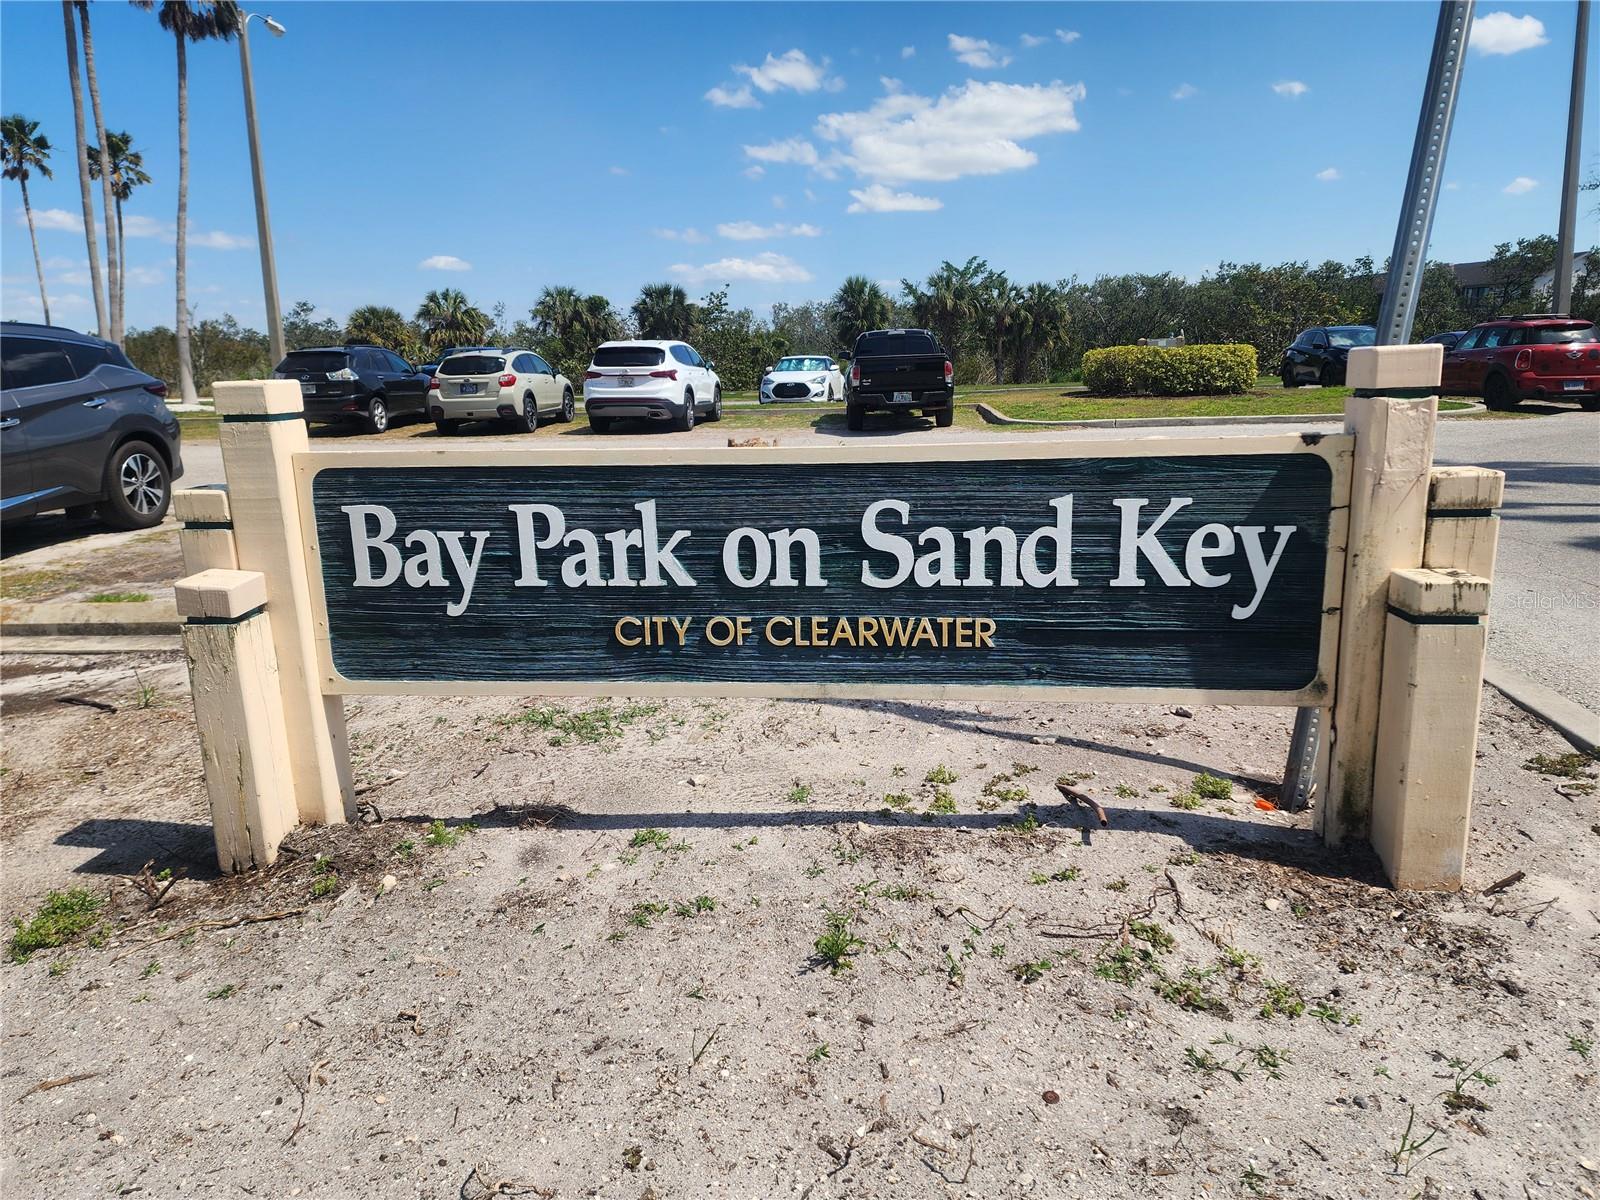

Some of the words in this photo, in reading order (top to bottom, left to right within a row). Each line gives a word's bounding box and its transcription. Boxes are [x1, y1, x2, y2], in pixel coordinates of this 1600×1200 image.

[340, 503, 490, 617] Bay
[508, 498, 698, 588] Park
[722, 526, 828, 588] on
[861, 494, 1078, 589] Sand
[1110, 496, 1297, 620] Key
[614, 616, 693, 647] CITY
[705, 615, 754, 647] OF
[766, 615, 996, 649] CLEARWATER
